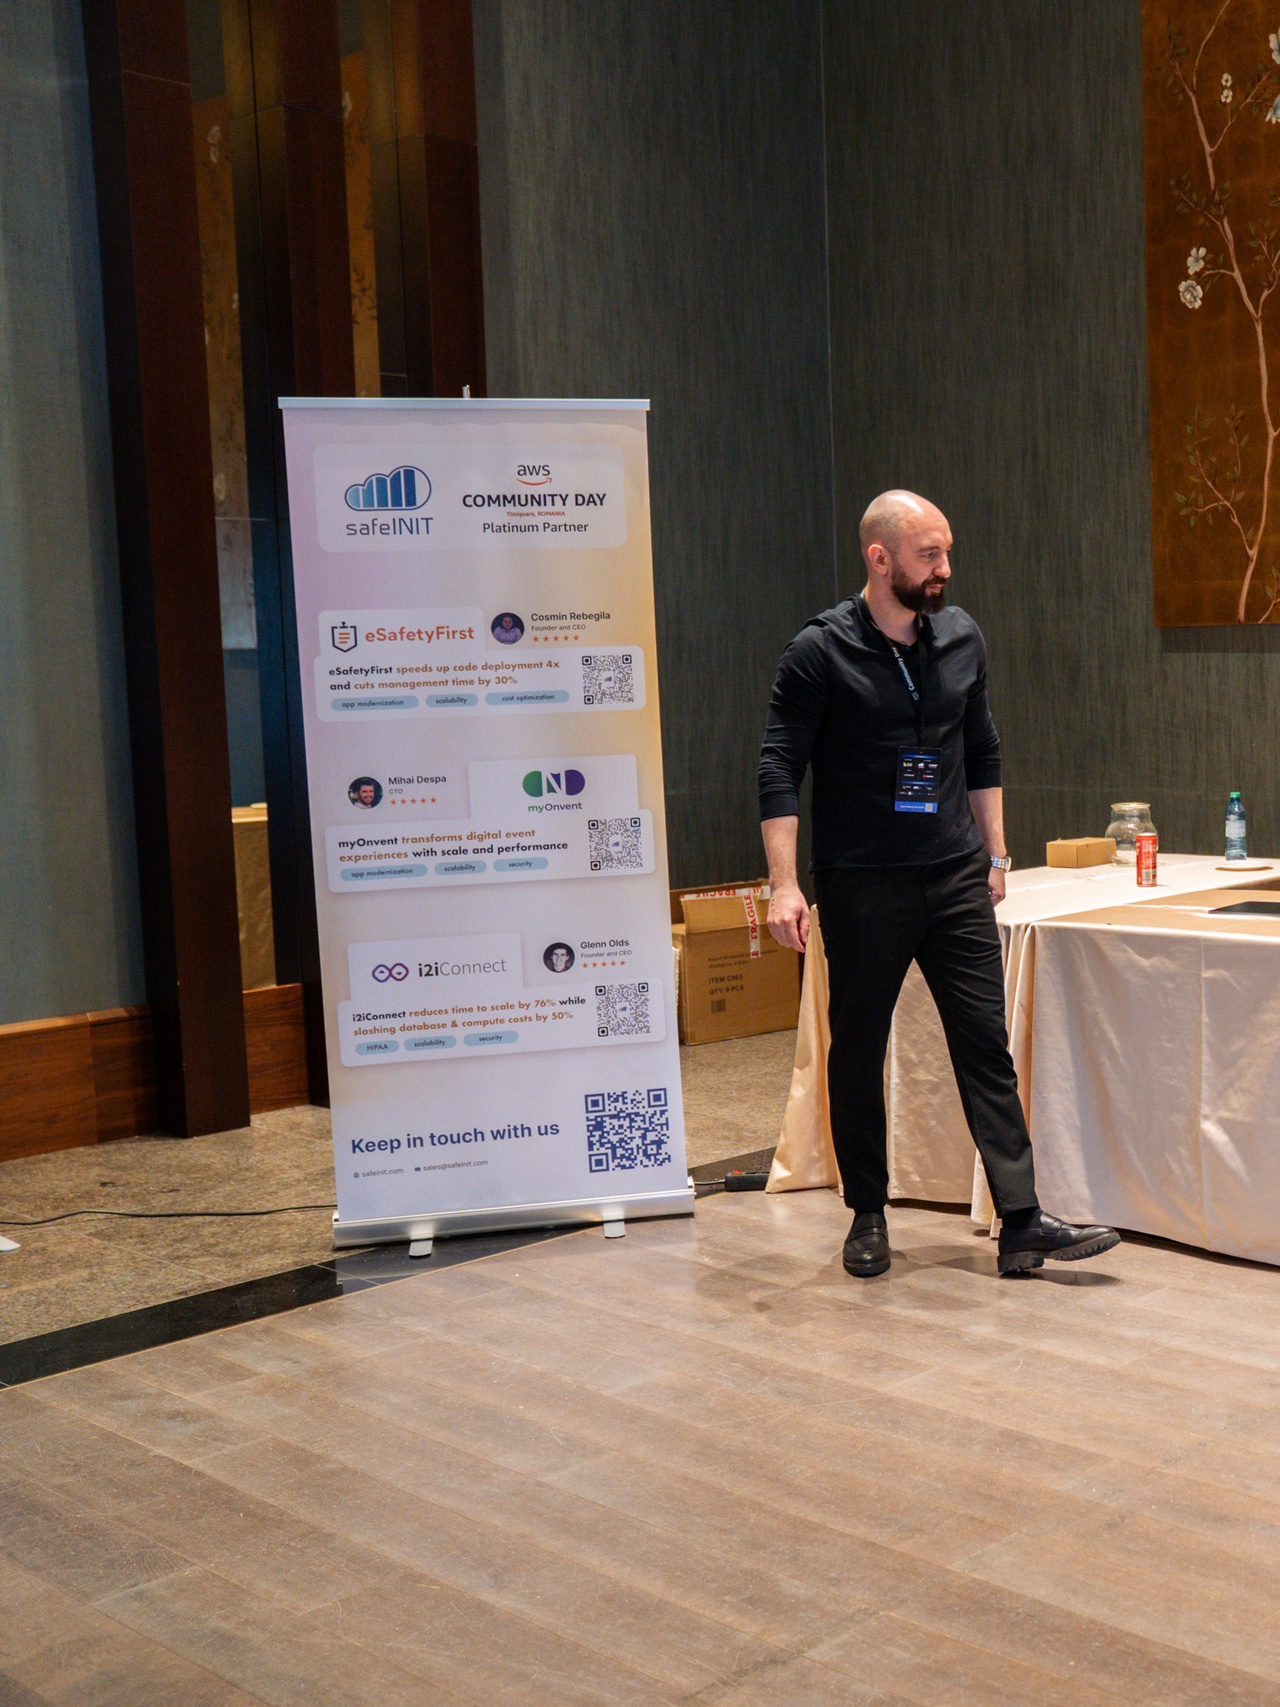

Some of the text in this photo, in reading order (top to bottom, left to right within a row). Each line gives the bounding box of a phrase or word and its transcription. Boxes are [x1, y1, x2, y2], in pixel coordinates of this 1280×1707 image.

[517, 464, 551, 477] aws
[462, 493, 607, 508] COMMUNITY DAY
[346, 517, 434, 536] safeINIT
[483, 522, 589, 533] Platinum Partner
[530, 612, 568, 622] Cosmin
[365, 625, 475, 643] eSafetyFirst
[329, 660, 560, 677] eSafetyFirst speeds up code deployment 4x
[897, 658, 915, 691] Community
[329, 675, 518, 691] and cuts management time by 30%
[357, 699, 404, 707] modernization
[435, 697, 467, 705] scalability
[516, 694, 555, 702] optimization
[388, 775, 447, 785] Mihai Despa
[527, 802, 583, 814] myOnvent
[338, 829, 536, 850] myOnvent transforms digital event
[339, 842, 569, 864] experiences with scale and performance
[444, 863, 476, 872] scalability
[508, 860, 533, 868] security
[366, 868, 414, 876] modernization
[743, 894, 758, 940] FRAGILE
[580, 939, 630, 949] Glenn Olds
[418, 959, 507, 977] i2iConnect
[352, 996, 586, 1022] i2iConnect reduces time to scale by 76% while
[353, 1011, 574, 1036] slashing database & compute costs by 50%
[414, 1038, 446, 1047] scalability
[478, 1034, 503, 1042] security
[366, 1043, 389, 1051] HIPAA
[351, 1123, 560, 1154] Keep in touch with us
[361, 1167, 404, 1178] safeinit.com
